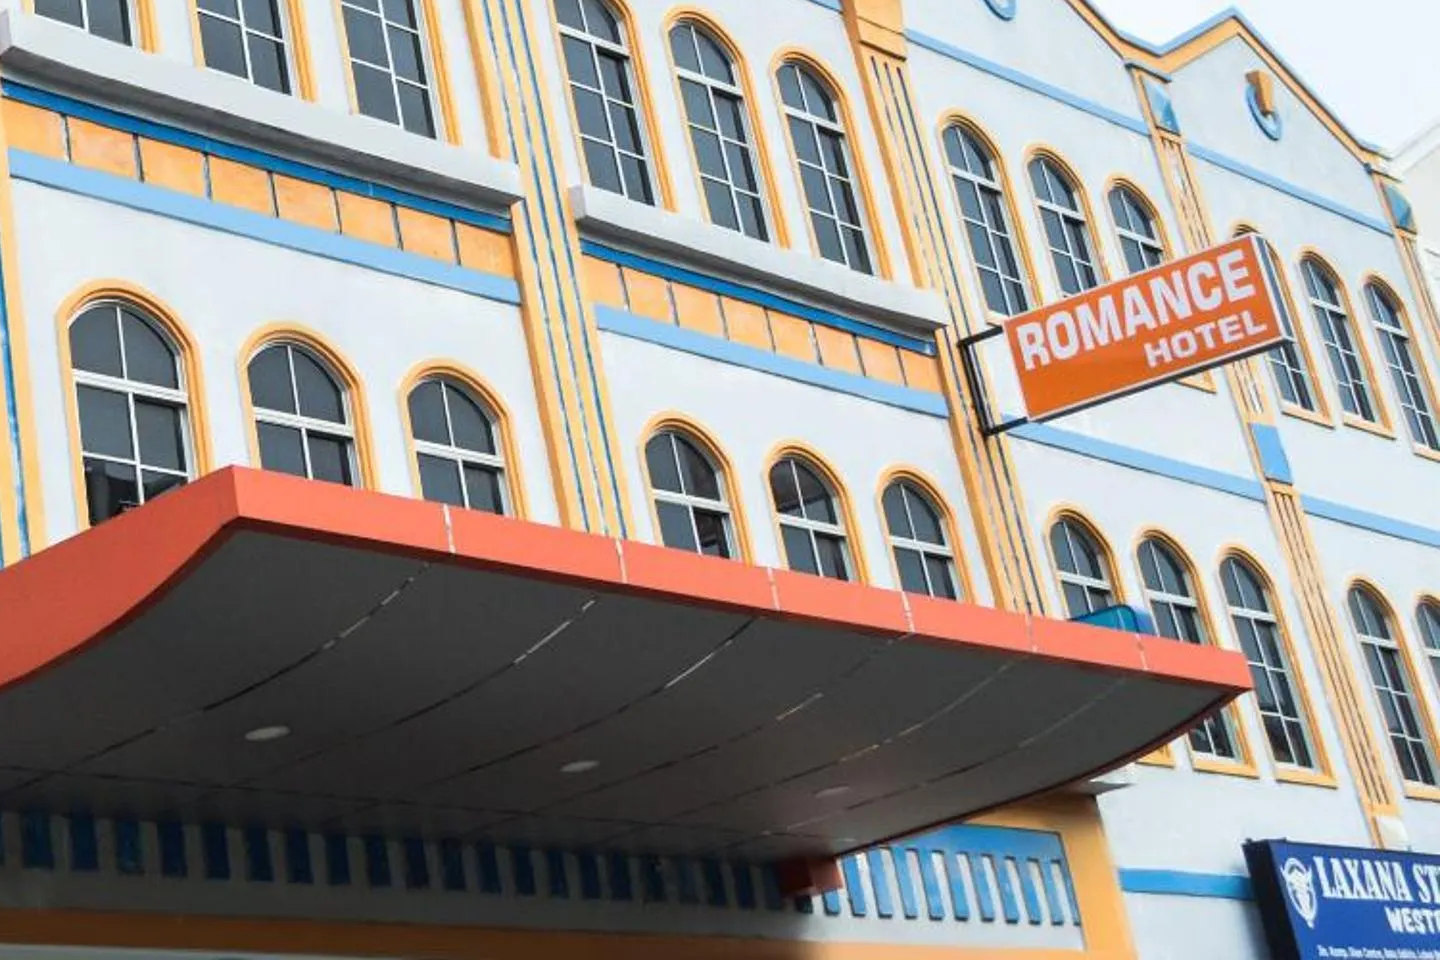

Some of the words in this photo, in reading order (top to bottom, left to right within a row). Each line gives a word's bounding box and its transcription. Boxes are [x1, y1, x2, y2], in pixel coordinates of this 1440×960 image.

[1016, 248, 1255, 372] ROMANCE
[1143, 310, 1268, 369] HOTEL
[1313, 855, 1413, 901] LAXANA
